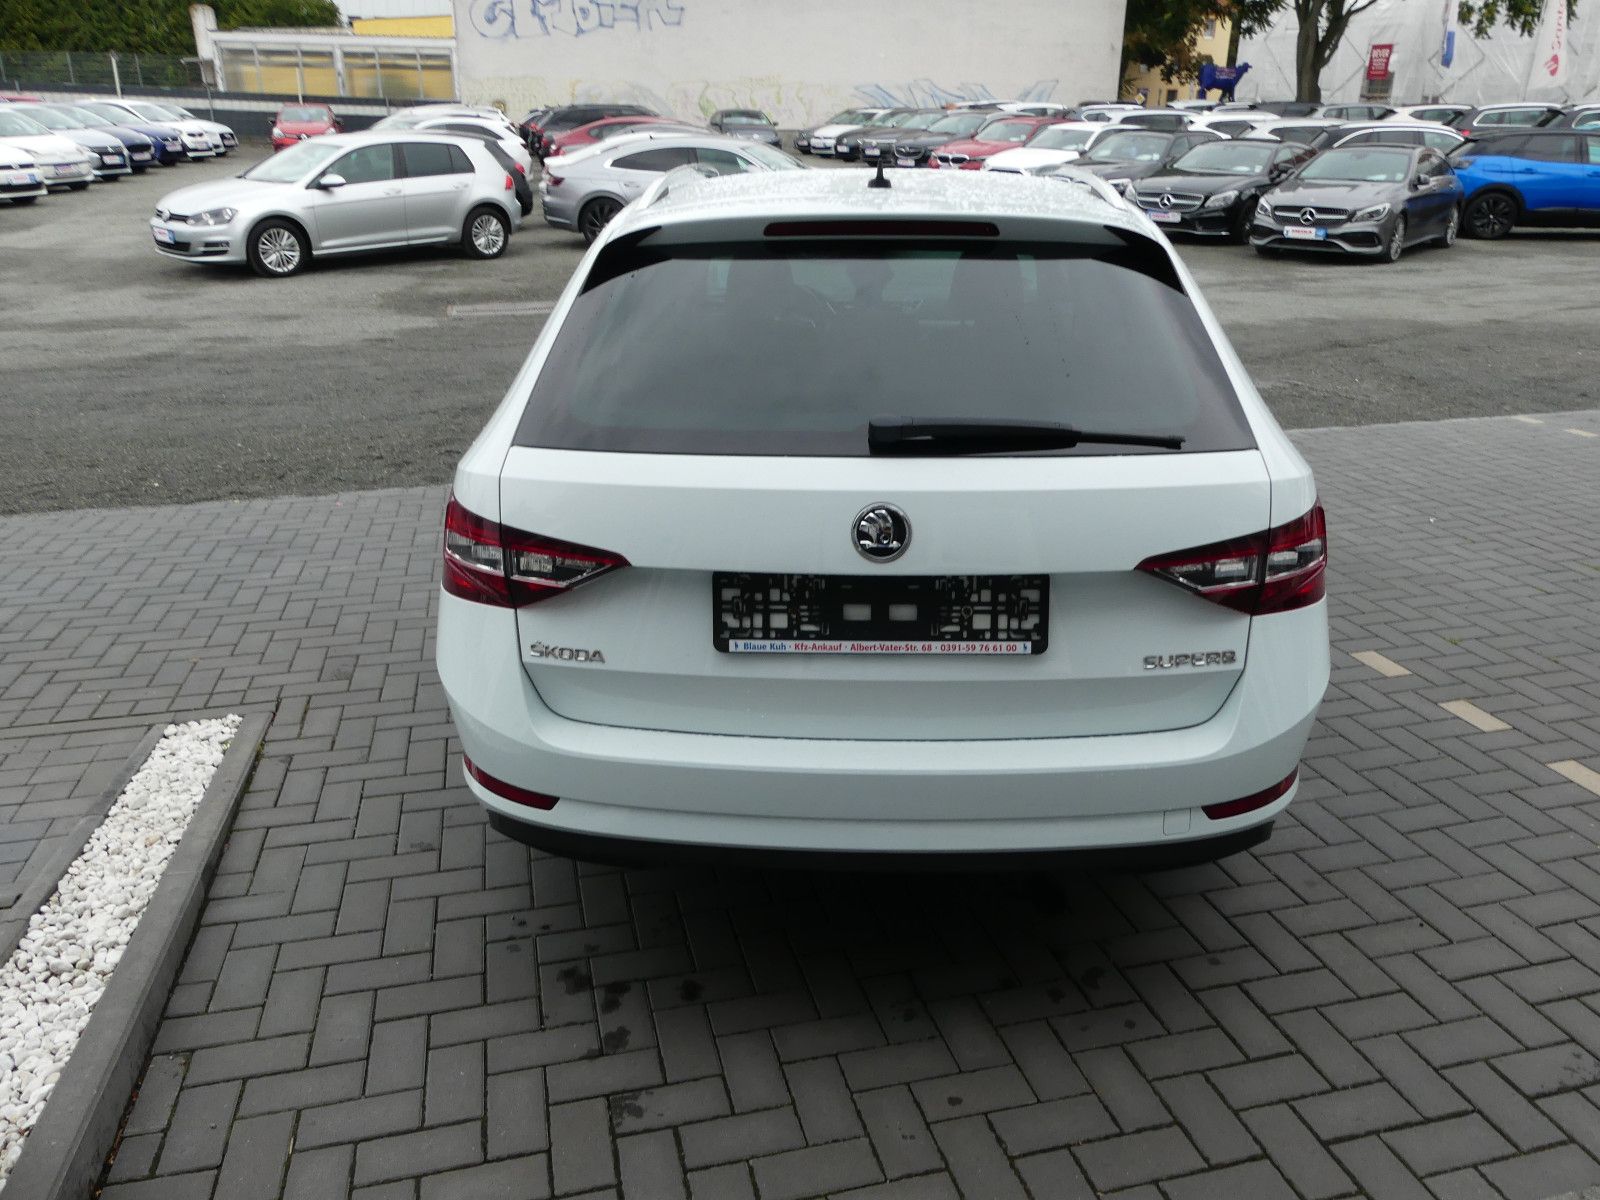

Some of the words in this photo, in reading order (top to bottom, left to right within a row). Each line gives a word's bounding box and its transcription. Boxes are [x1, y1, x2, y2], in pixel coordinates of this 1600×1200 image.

[743, 641, 767, 650] Blaue
[769, 642, 787, 650] Kuh
[794, 642, 842, 651] Kfz-Ankauf
[850, 643, 919, 651] Albert-Vater-Str.
[921, 643, 933, 652] 68
[940, 644, 976, 652] 0391-59
[979, 644, 990, 652] 76
[992, 644, 1002, 652] 61
[1005, 644, 1017, 652] 00
[1143, 651, 1236, 669] SUPERB
